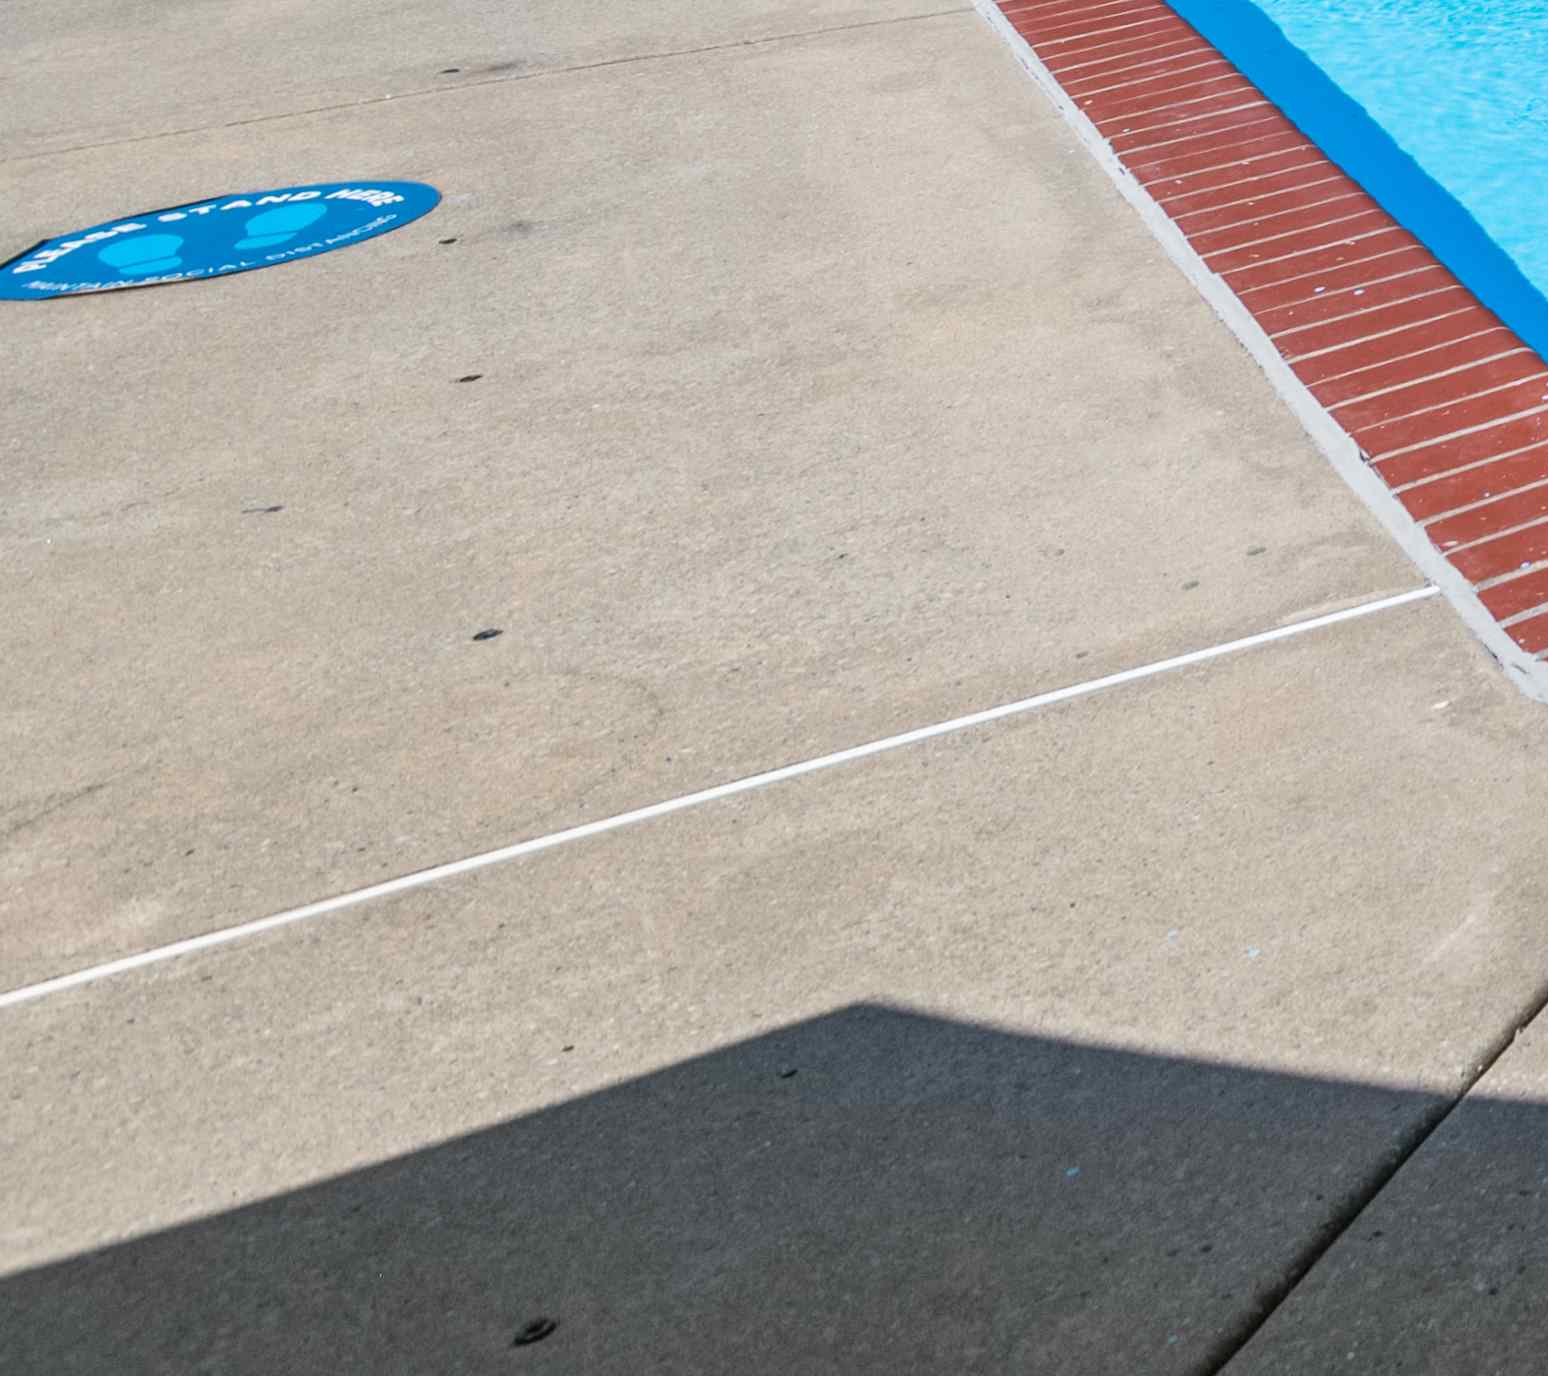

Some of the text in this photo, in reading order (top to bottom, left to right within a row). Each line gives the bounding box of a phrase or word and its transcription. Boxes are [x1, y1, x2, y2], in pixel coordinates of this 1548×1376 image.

[12, 189, 405, 274] PLEASE STAND HERE
[143, 260, 256, 283] SOCIAL
